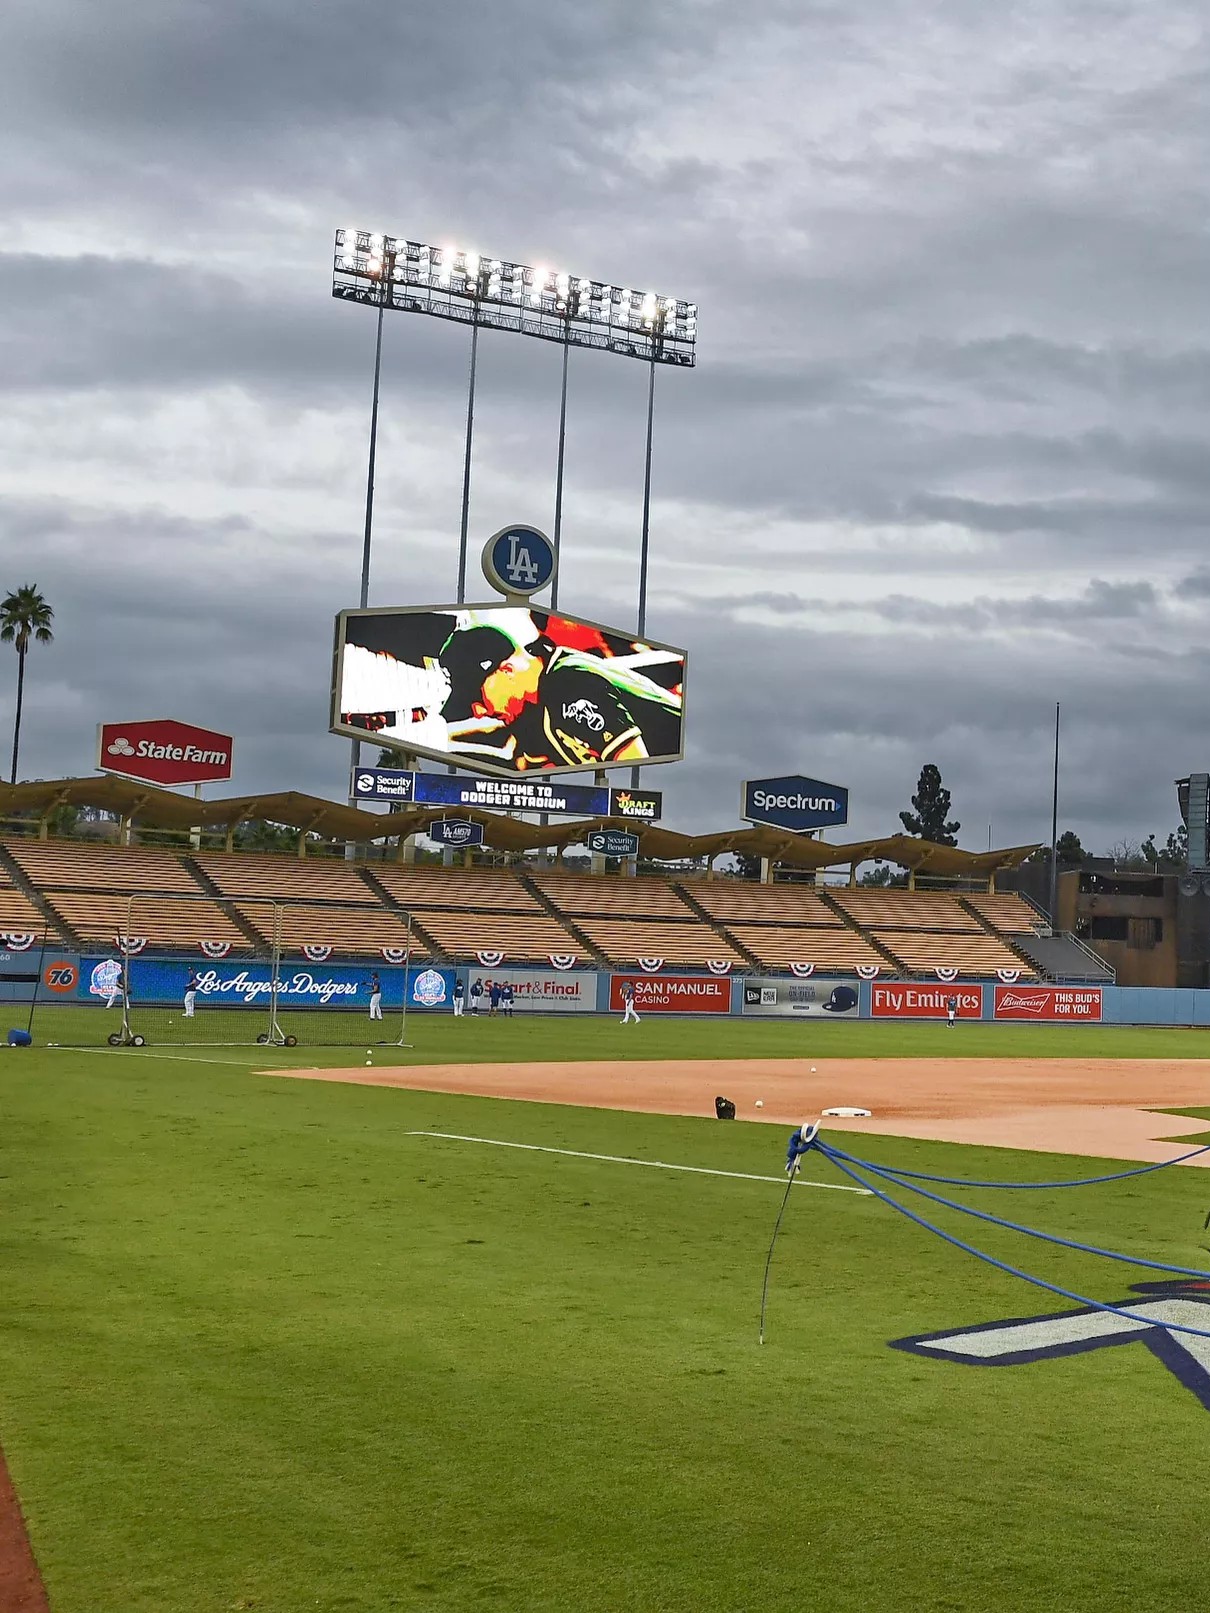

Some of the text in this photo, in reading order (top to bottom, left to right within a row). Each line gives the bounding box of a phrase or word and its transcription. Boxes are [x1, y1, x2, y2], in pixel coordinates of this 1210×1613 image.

[507, 535, 538, 583] LA
[376, 775, 411, 788] Security
[376, 785, 409, 795] Benefit
[475, 781, 553, 798] WELCOME TO
[461, 791, 566, 810] DODGER STADIUM
[618, 799, 656, 809] DRAFT
[753, 790, 836, 812] Spectrum
[622, 807, 655, 817] KINGS
[607, 835, 634, 845] Security
[48, 967, 74, 986] 76
[195, 970, 221, 994] Los
[288, 972, 358, 1003] Dodgers
[635, 982, 722, 995] SAN MANUEL
[635, 995, 670, 1004] CASINO
[875, 990, 979, 1010] Fly Emirtes
[1005, 996, 1045, 1007] Budweiser
[1054, 993, 1100, 1004] THIS BUD'S
[1054, 1004, 1092, 1014] FOR YOU.
